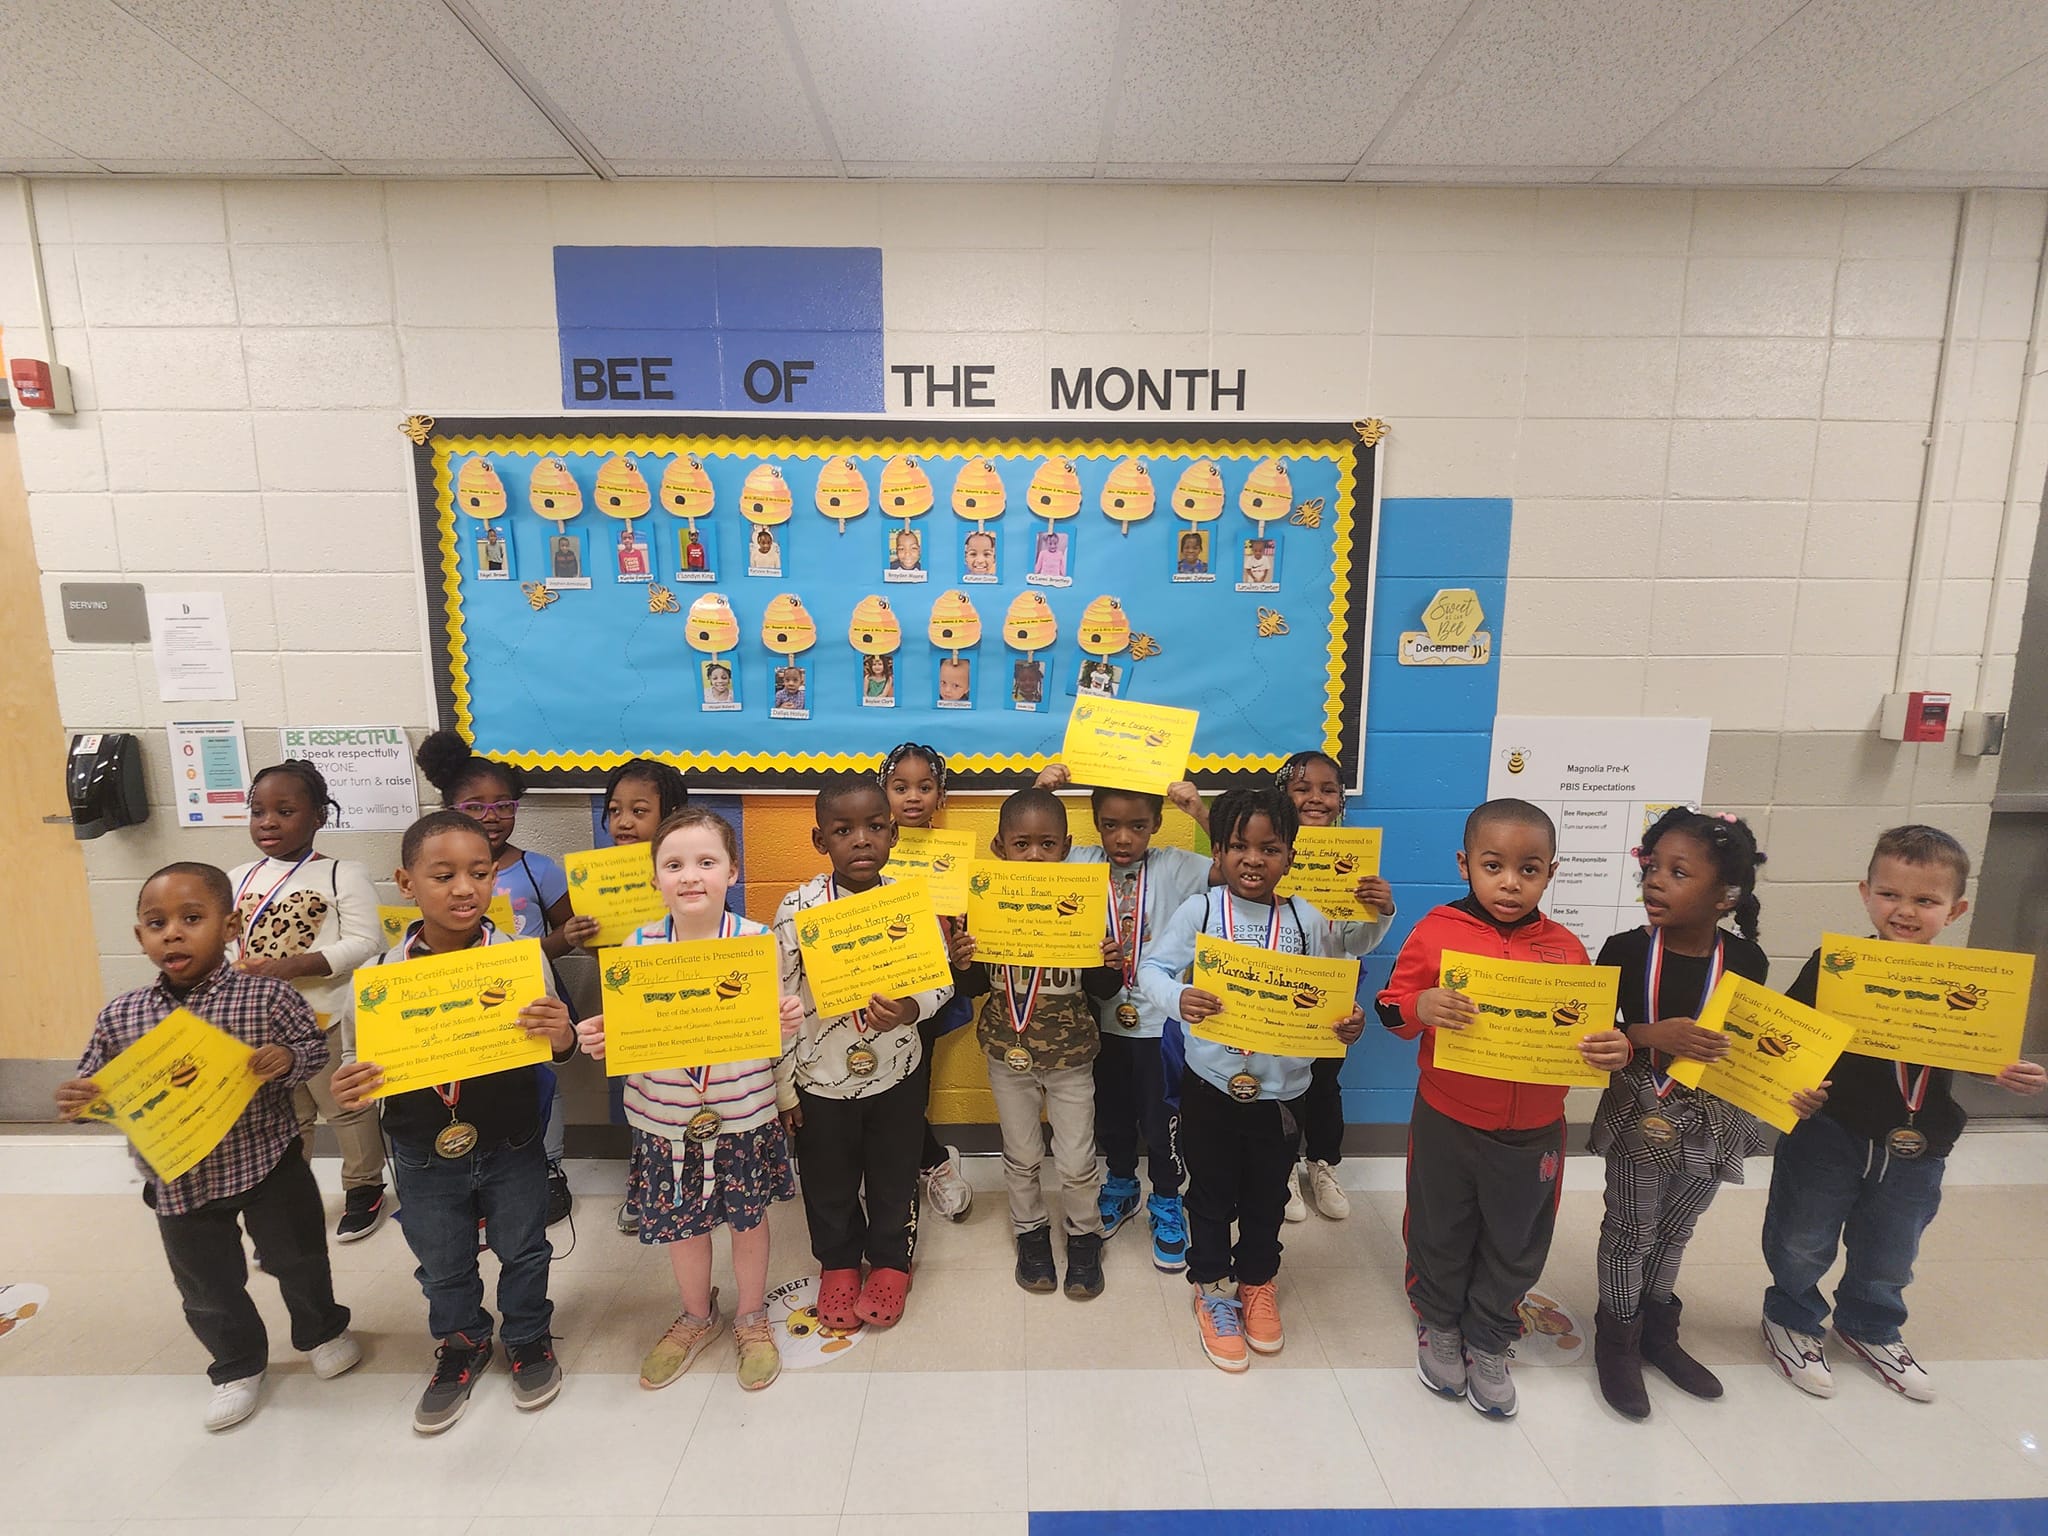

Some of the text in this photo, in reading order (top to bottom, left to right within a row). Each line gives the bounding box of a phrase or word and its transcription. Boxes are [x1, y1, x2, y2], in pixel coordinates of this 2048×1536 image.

[573, 358, 1246, 411] BEE OF THE MONTH
[70, 601, 108, 610] SERVING
[1430, 596, 1476, 620] Sweet
[1438, 620, 1466, 641] Bee
[1416, 643, 1469, 652] December
[286, 729, 402, 746] BE RESPECTFUL
[285, 747, 399, 760] 10. Speak respectfully
[1567, 765, 1630, 775] Magnolia Pre-K
[350, 777, 371, 786] turn
[375, 777, 382, 786] &
[385, 776, 412, 786] raise
[1560, 783, 1636, 793] PBIS Expectations
[348, 803, 364, 815] be
[367, 804, 399, 816] willing
[402, 804, 413, 814] to
[993, 872, 1091, 883] This Certificate Presented
[1001, 886, 1053, 898] Nigel Brown
[820, 890, 920, 925] This Certificate Presented to
[828, 915, 889, 938] Brayden Moore
[1280, 927, 1292, 935] TO
[888, 943, 906, 952] Award
[1280, 936, 1292, 944] TO
[1280, 945, 1292, 953] TO
[633, 949, 764, 969] This Certificate is Presented to
[1222, 952, 1240, 962] This
[1241, 957, 1284, 972] Certificate
[1285, 965, 1293, 973] is
[1295, 967, 1336, 978] Presented
[1860, 953, 2014, 976] This Certificate is Presented to
[391, 976, 413, 986] This
[415, 967, 464, 982] Certificate
[466, 963, 474, 971] is
[476, 956, 518, 970] Presented
[1473, 969, 1493, 980] This
[1495, 973, 1543, 986] Certificate
[1544, 978, 1552, 986] is
[1554, 978, 1596, 989] Presented
[1887, 971, 1922, 983] Wyatt
[1265, 970, 1315, 990] Johnson
[401, 985, 439, 1001] Micah
[690, 1006, 713, 1014] Month
[714, 1003, 736, 1011] Award
[1267, 1007, 1288, 1016] Month
[1478, 1002, 1547, 1018] Busy Bees
[1901, 1006, 1913, 1014] the
[1914, 1008, 1939, 1017] Month
[1941, 1013, 1966, 1022] Award
[414, 1012, 501, 1034] Bee the Month Award
[1764, 1003, 1832, 1041] is Presented to
[1524, 1027, 1547, 1035] Month
[619, 1043, 649, 1052] Continue
[671, 1036, 705, 1047] Respectful,
[706, 1032, 743, 1042] Responsible
[752, 1028, 768, 1036] Safe!
[1886, 1032, 1970, 1050] Respectful, Responsible
[415, 1040, 509, 1064] Bee Respectful, Responsible
[1448, 1043, 1476, 1053] Continue
[1499, 1052, 1534, 1063] Respectful,
[1536, 1056, 1573, 1065] Responsible
[768, 1277, 810, 1301] SWEET
